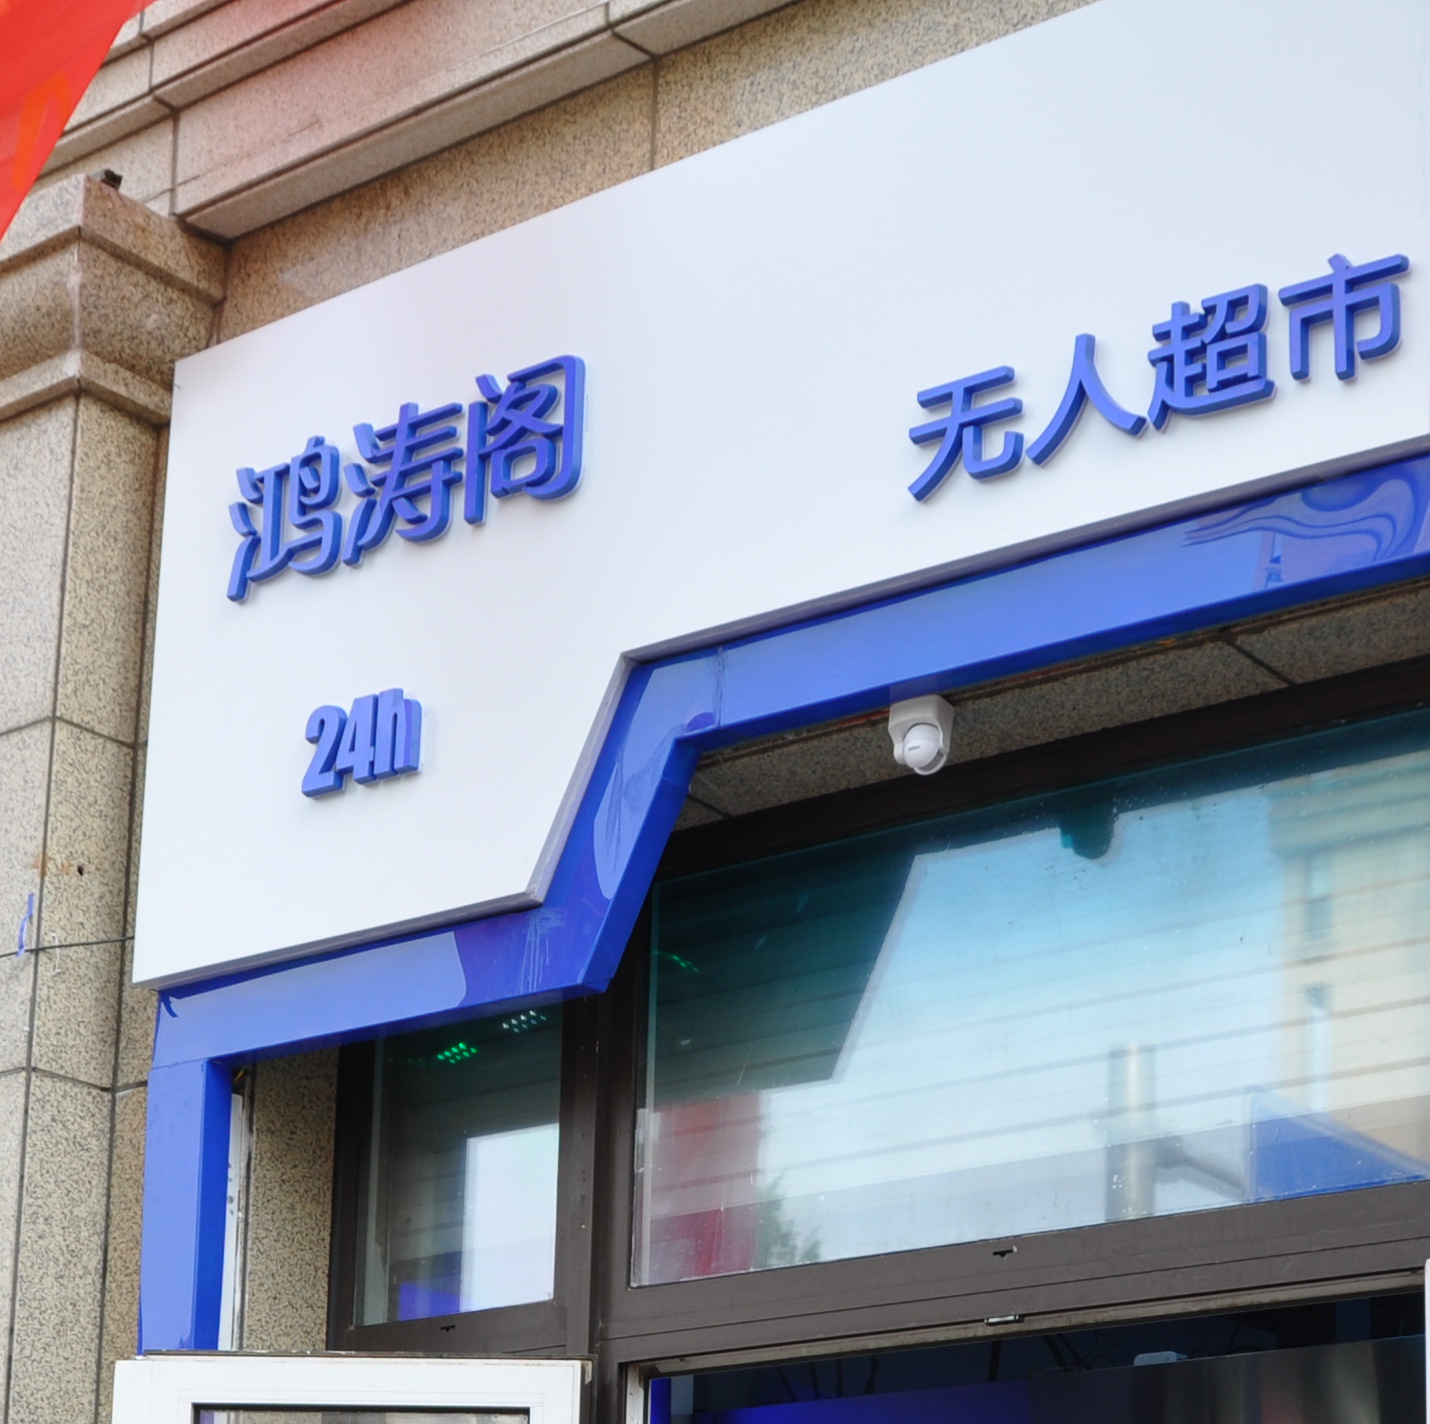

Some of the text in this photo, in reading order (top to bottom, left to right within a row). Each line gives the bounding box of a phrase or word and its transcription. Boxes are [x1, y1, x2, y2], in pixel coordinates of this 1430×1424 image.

[226, 354, 586, 602] 鸿涛阁
[907, 252, 1410, 503] 无人超市
[301, 687, 423, 798] 24h
